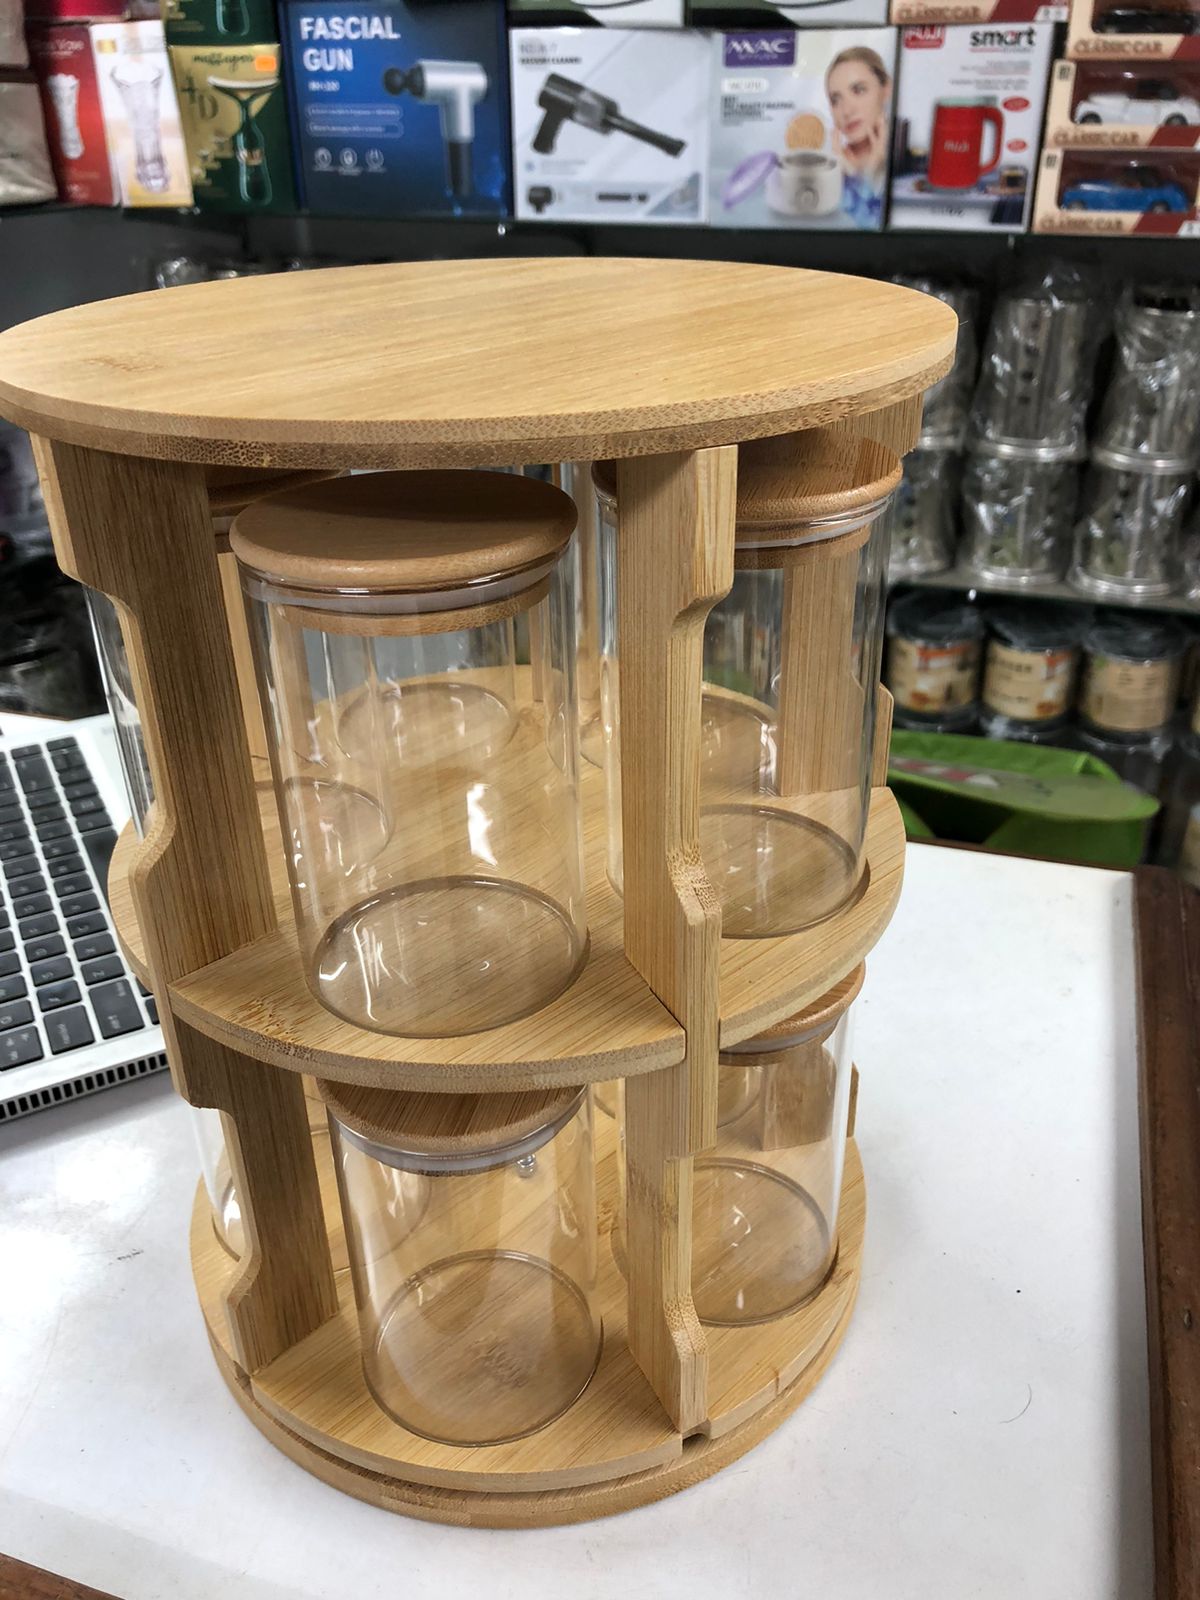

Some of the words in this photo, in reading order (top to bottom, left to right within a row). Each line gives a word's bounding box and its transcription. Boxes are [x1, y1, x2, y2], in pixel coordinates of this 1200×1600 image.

[300, 16, 400, 40] FASCIAL
[969, 26, 1035, 47] smart
[727, 39, 791, 54] MAC
[1074, 40, 1129, 53] CLASSIC
[1133, 41, 1163, 54] CAR
[303, 48, 354, 71] GUN
[1053, 130, 1108, 146] CLASSIC
[1111, 131, 1139, 146] CAR
[1095, 216, 1123, 231] CAR
